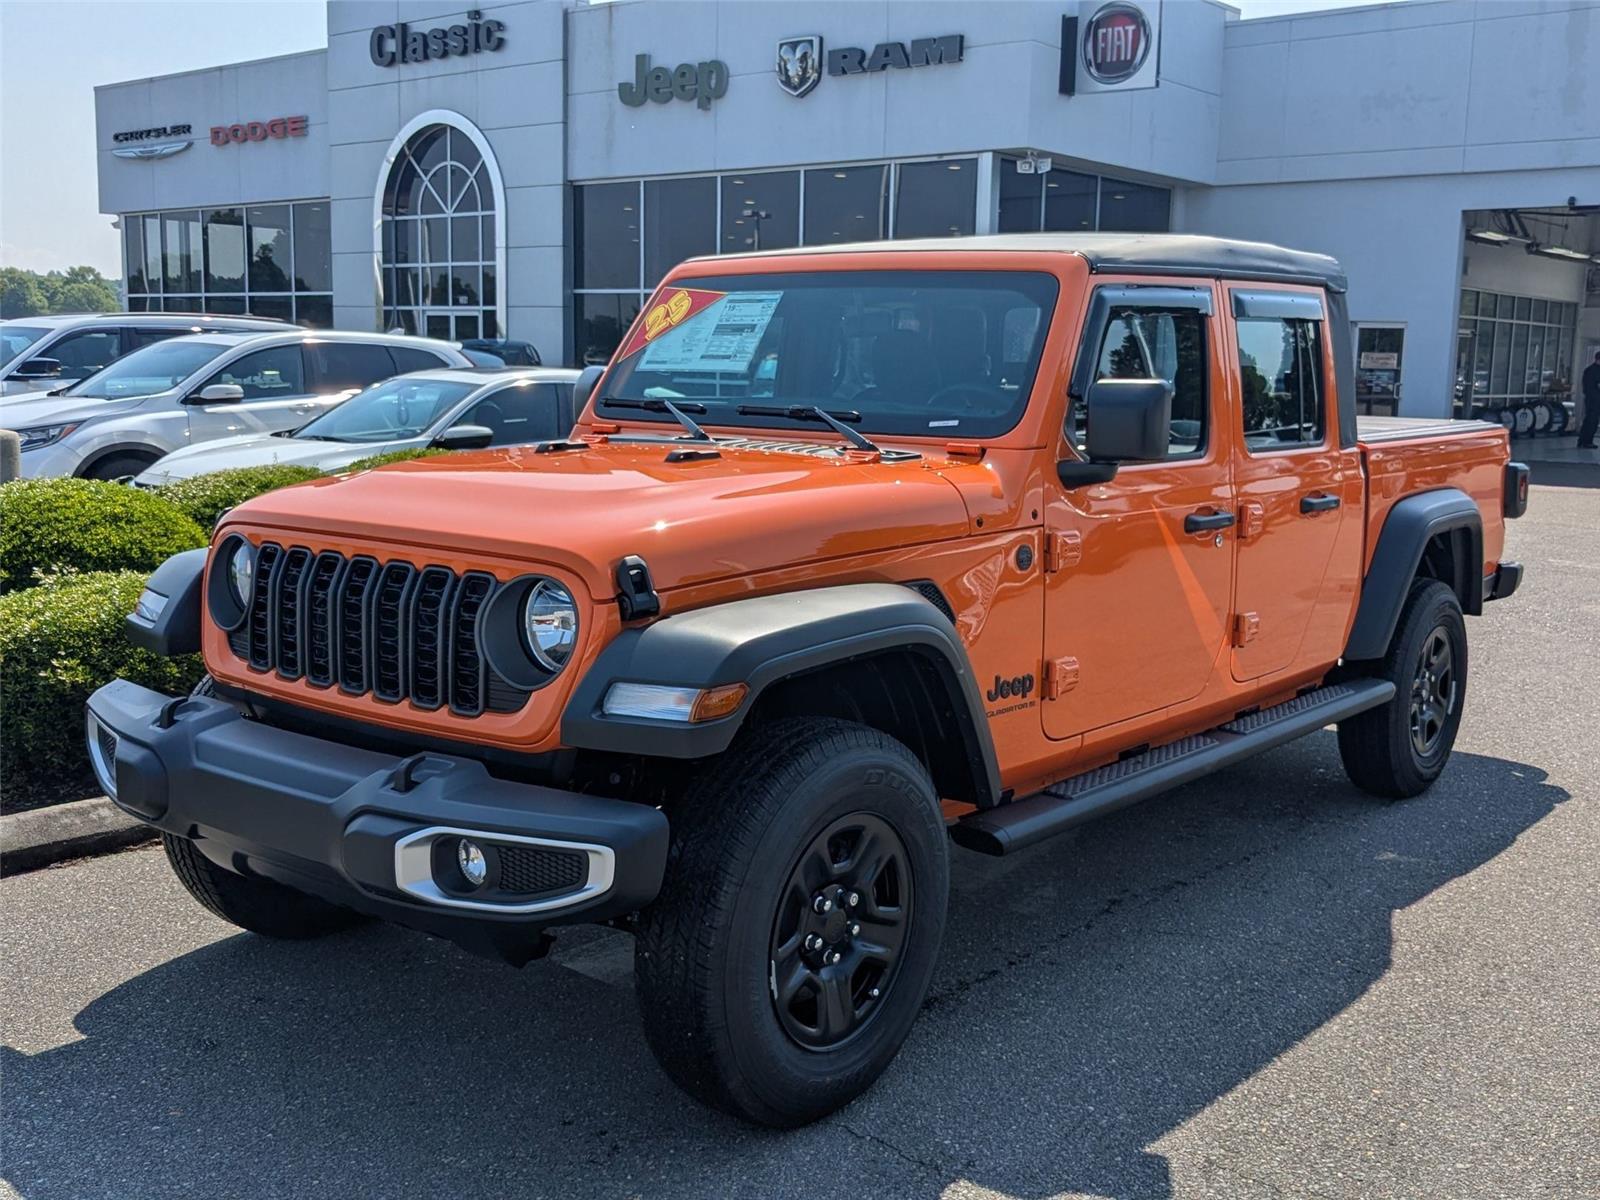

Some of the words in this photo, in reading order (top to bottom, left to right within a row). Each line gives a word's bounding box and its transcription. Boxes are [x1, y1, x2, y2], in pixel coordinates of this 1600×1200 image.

[370, 10, 505, 67] Classic
[827, 34, 965, 76] RAM
[1096, 24, 1136, 64] FIAT
[618, 53, 729, 110] Jeep
[113, 124, 192, 142] CHRYSLER
[210, 115, 308, 146] DODGE
[643, 289, 693, 341] 25
[986, 673, 1034, 702] Jeep
[985, 702, 1028, 718] GLADIATOR
